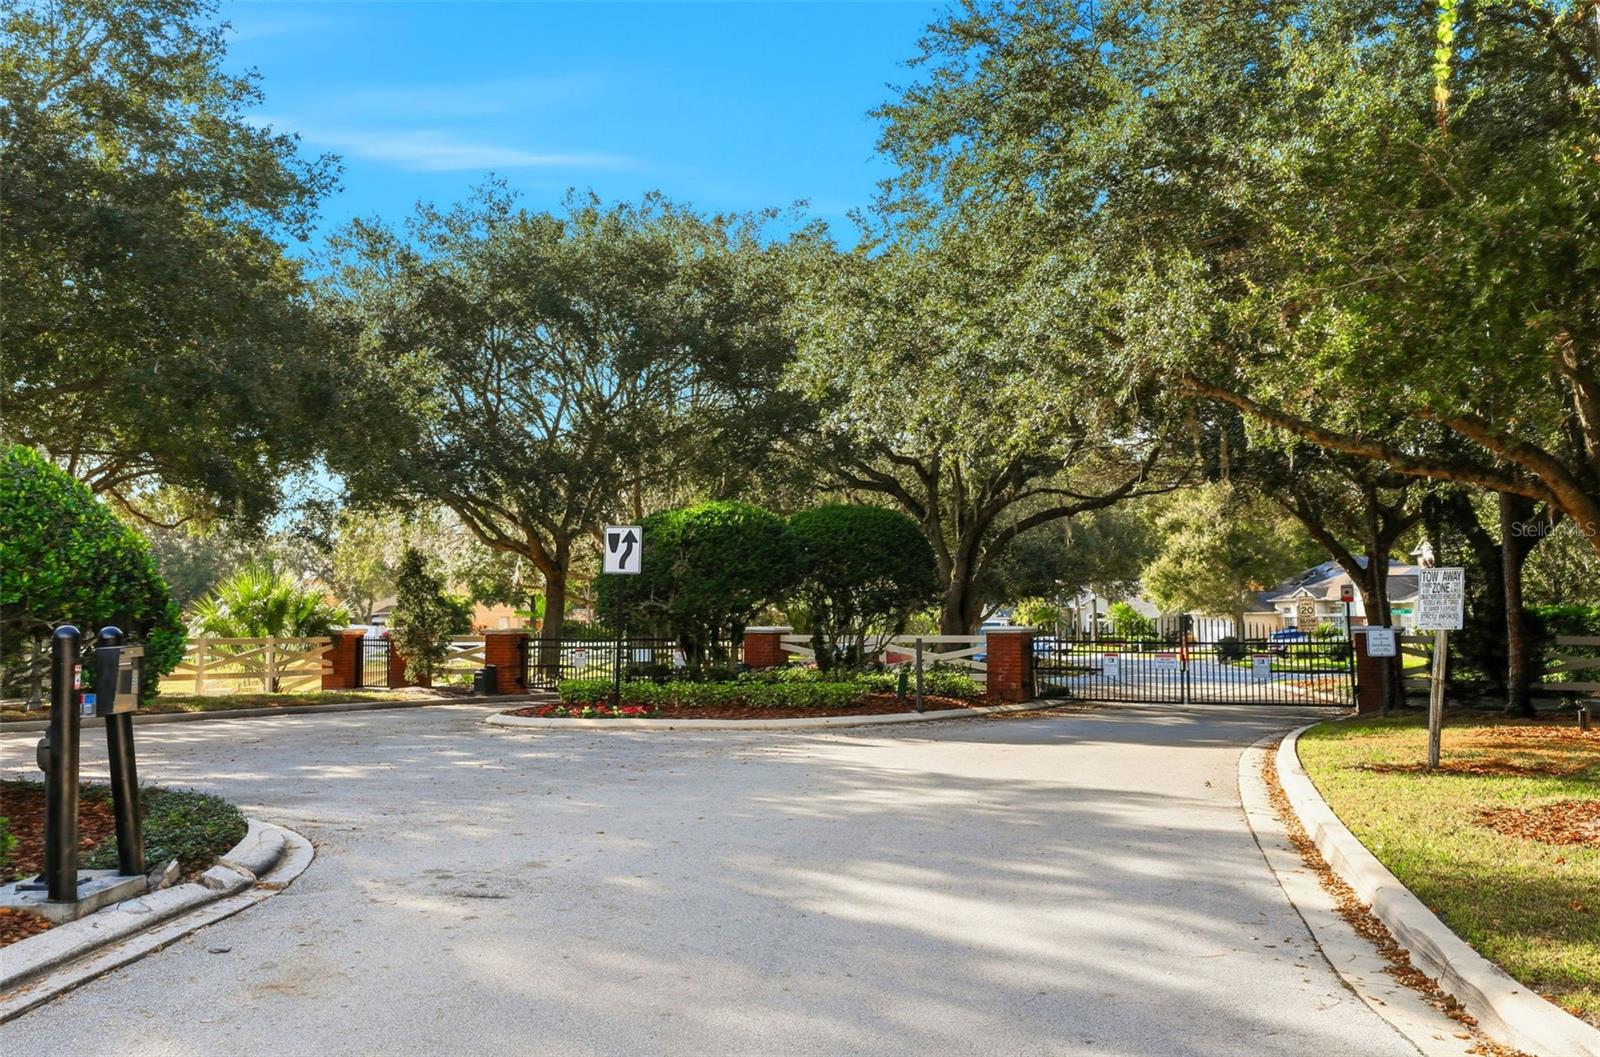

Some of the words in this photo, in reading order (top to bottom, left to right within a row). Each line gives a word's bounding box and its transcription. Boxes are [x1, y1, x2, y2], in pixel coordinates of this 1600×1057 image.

[1422, 571, 1438, 582] TOW
[1442, 571, 1461, 582] AWAY
[1432, 582, 1450, 593] ZONE
[1301, 606, 1314, 615] 20
